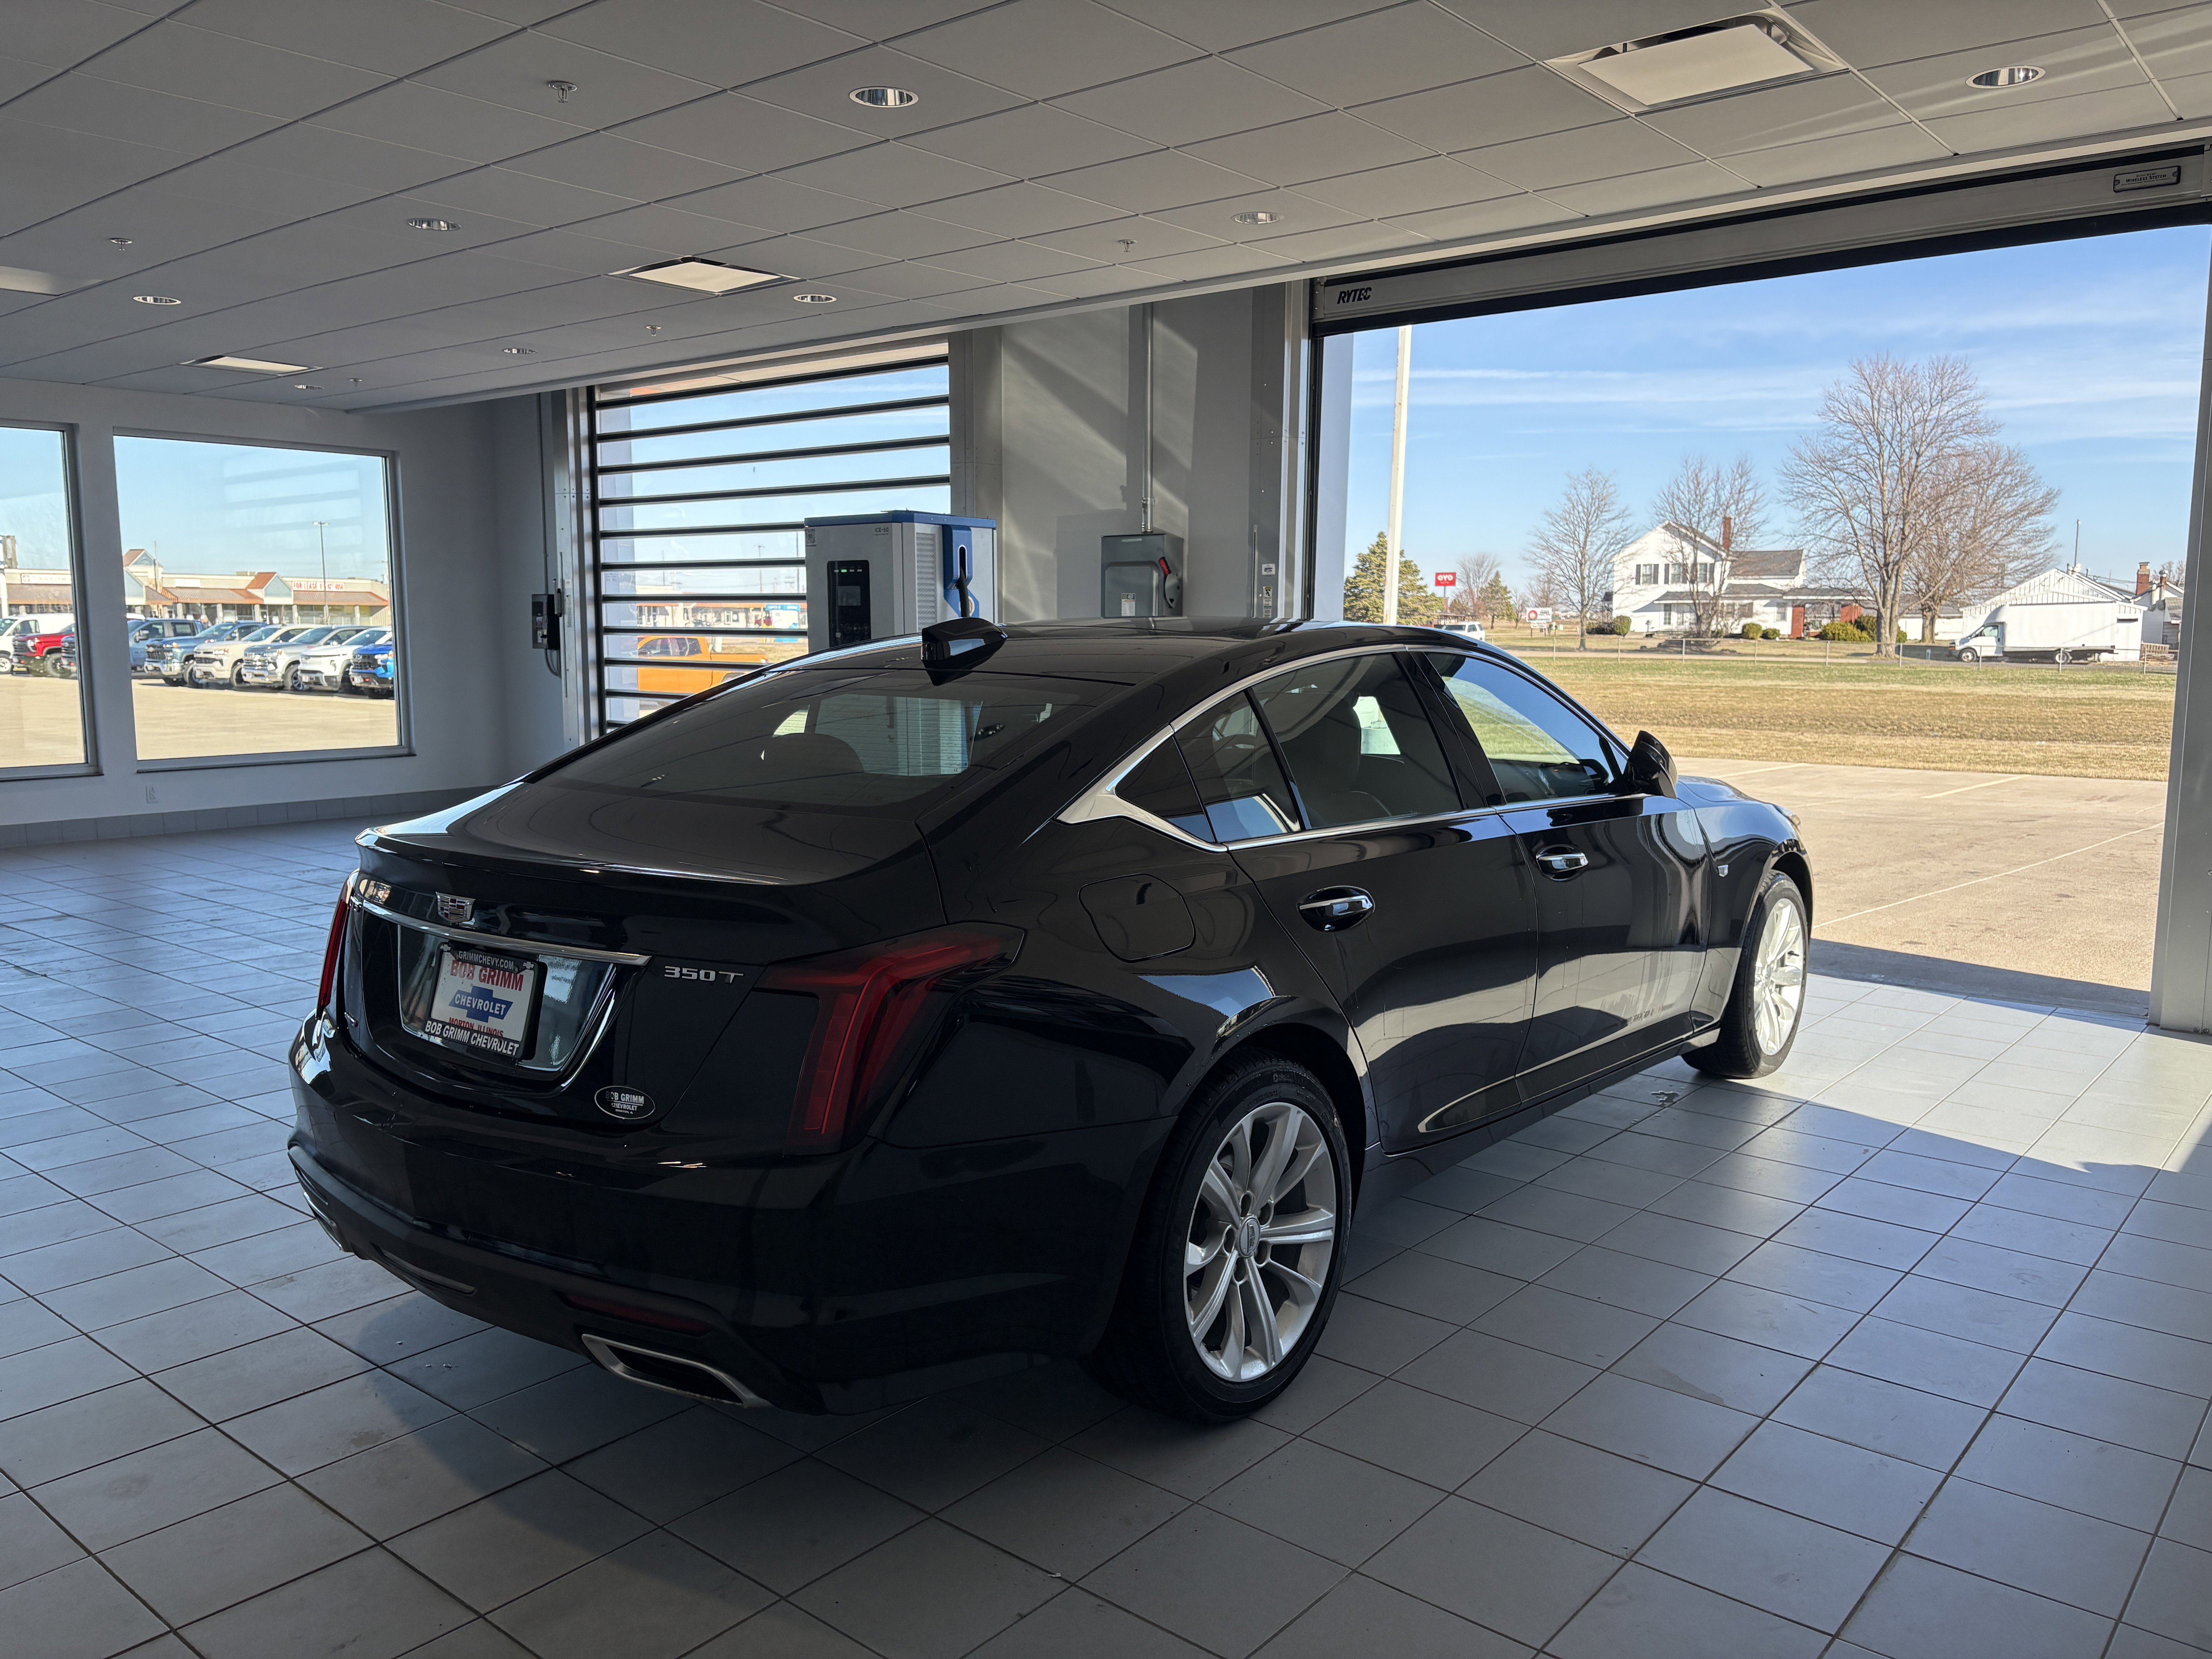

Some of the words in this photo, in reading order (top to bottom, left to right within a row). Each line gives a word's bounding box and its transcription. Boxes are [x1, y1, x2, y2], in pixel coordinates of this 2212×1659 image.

[1337, 287, 1372, 304] RYTEC
[459, 951, 514, 970] GRIMMCHEVY.COM
[450, 960, 476, 980] BOB
[479, 967, 524, 991] GRIMM
[455, 994, 506, 1015] CHEVROLET
[425, 1020, 442, 1035] BOB
[443, 1025, 471, 1043] GRIMM
[471, 1032, 520, 1056] CHEVROLET
[606, 1091, 619, 1100] BOB
[621, 1093, 644, 1104] GRIMM
[611, 1103, 637, 1111] CHEVROLET
